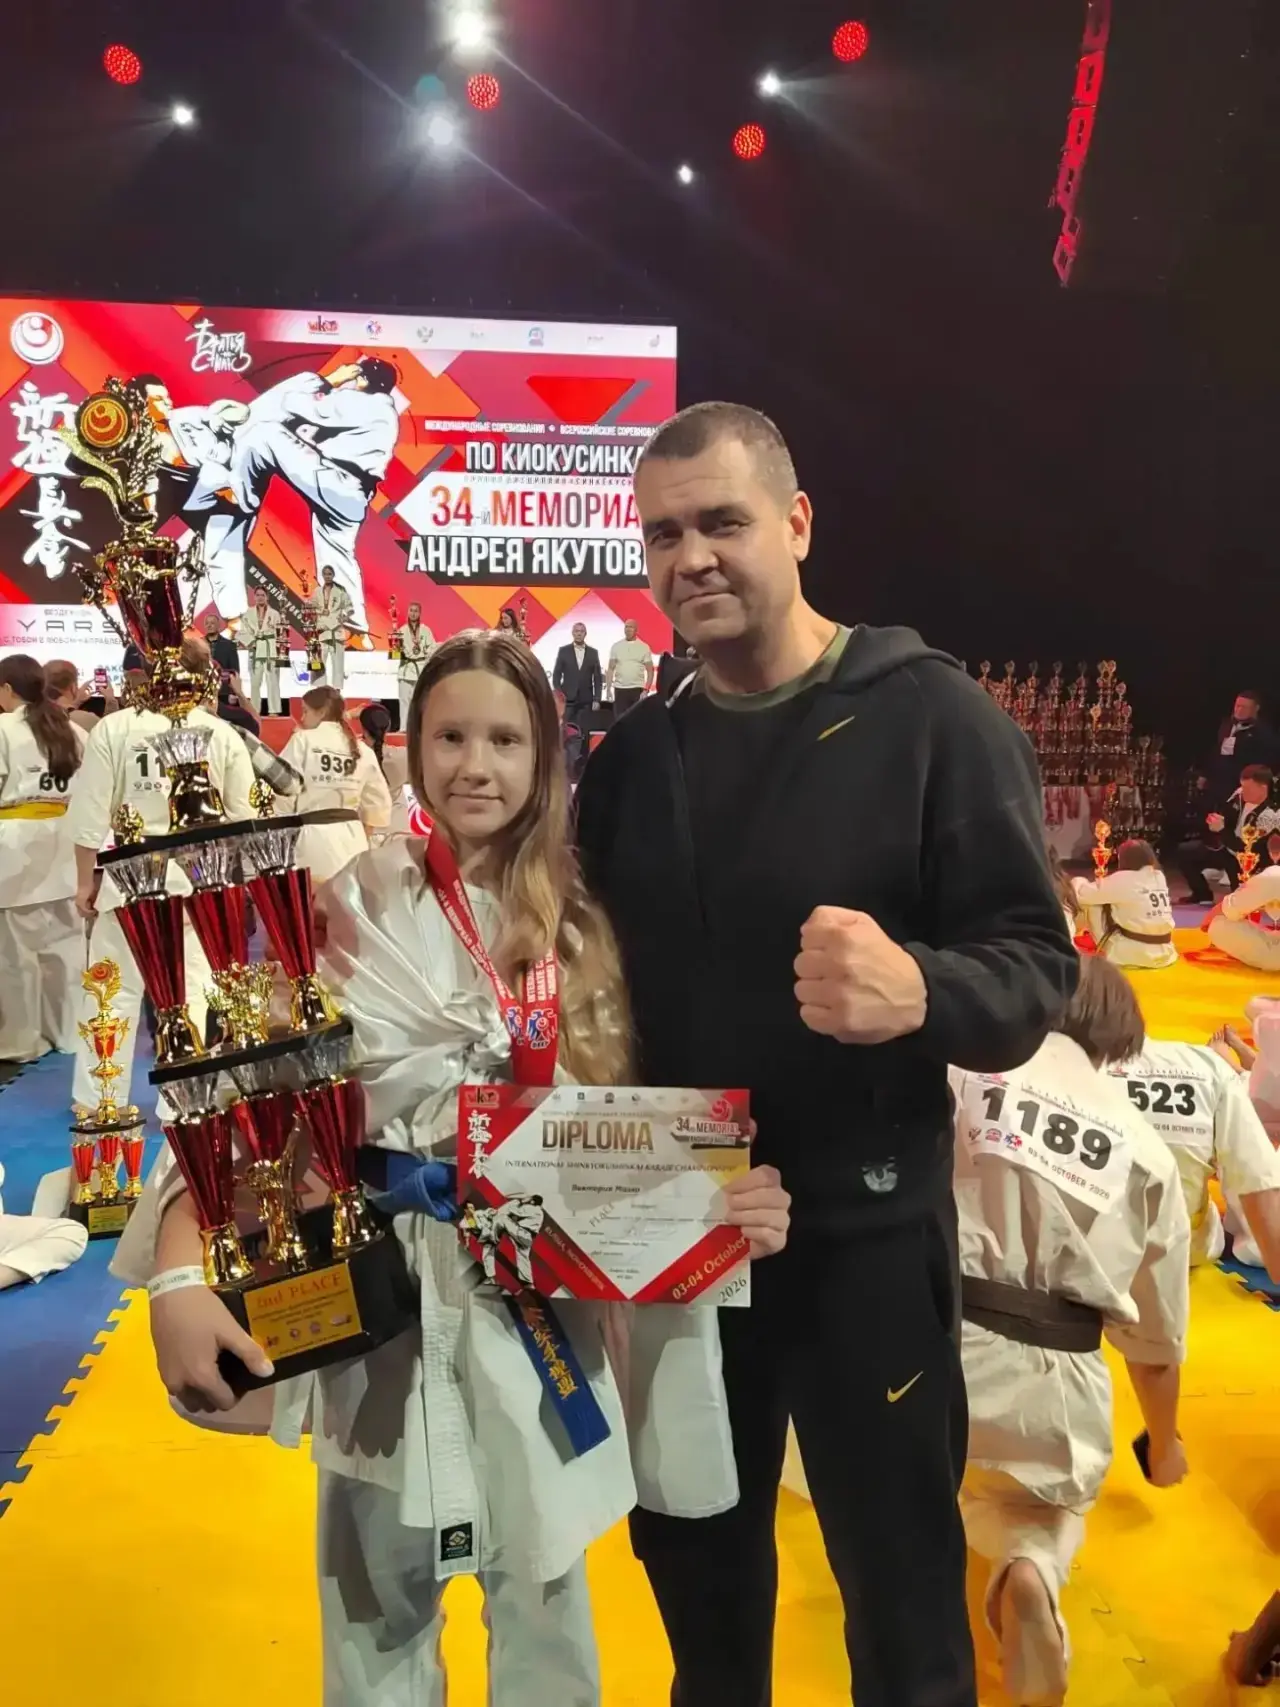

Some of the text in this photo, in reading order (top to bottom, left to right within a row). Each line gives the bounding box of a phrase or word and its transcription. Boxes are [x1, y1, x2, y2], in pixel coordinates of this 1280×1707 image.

[466, 442, 496, 470] ПО
[492, 490, 640, 528] МЕМОРИА
[407, 536, 648, 577] АНДРЕЯ ЯКУТОВ
[1149, 892, 1170, 908] 91
[1127, 1080, 1196, 1116] 523
[542, 1120, 654, 1150] DIPLOMA
[982, 1086, 1112, 1171] 1189
[672, 1235, 746, 1300] 03-04 October
[288, 1271, 341, 1298] PLACE
[718, 1276, 747, 1303] 2026
